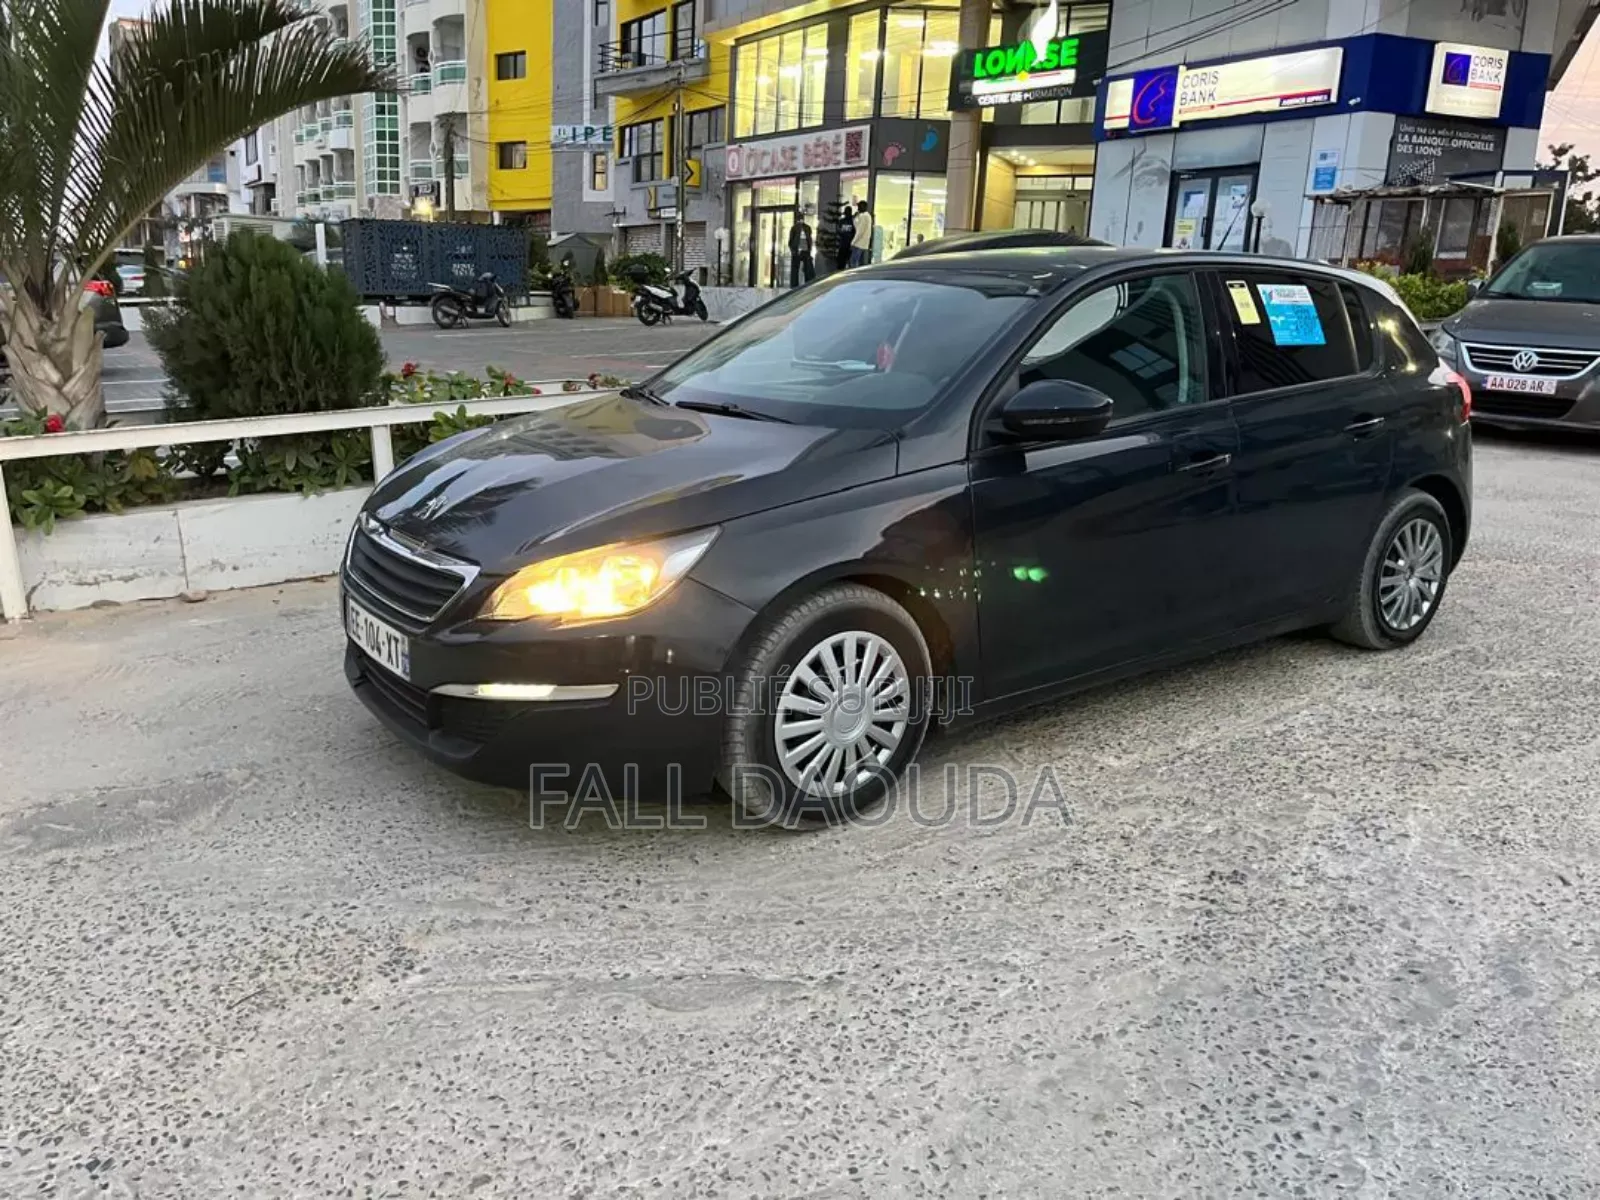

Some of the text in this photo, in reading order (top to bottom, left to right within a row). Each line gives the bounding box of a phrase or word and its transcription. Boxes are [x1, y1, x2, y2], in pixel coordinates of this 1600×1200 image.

[1473, 55, 1503, 70] CORIS
[1182, 70, 1220, 89] CORIS
[1471, 68, 1501, 83] BANK
[1179, 89, 1217, 106] BANK
[1398, 133, 1495, 152] LA BANQUE OFFICIELLE
[1396, 144, 1443, 157] DES LIONS
[1491, 377, 1504, 388] AA
[1529, 380, 1545, 392] AR
